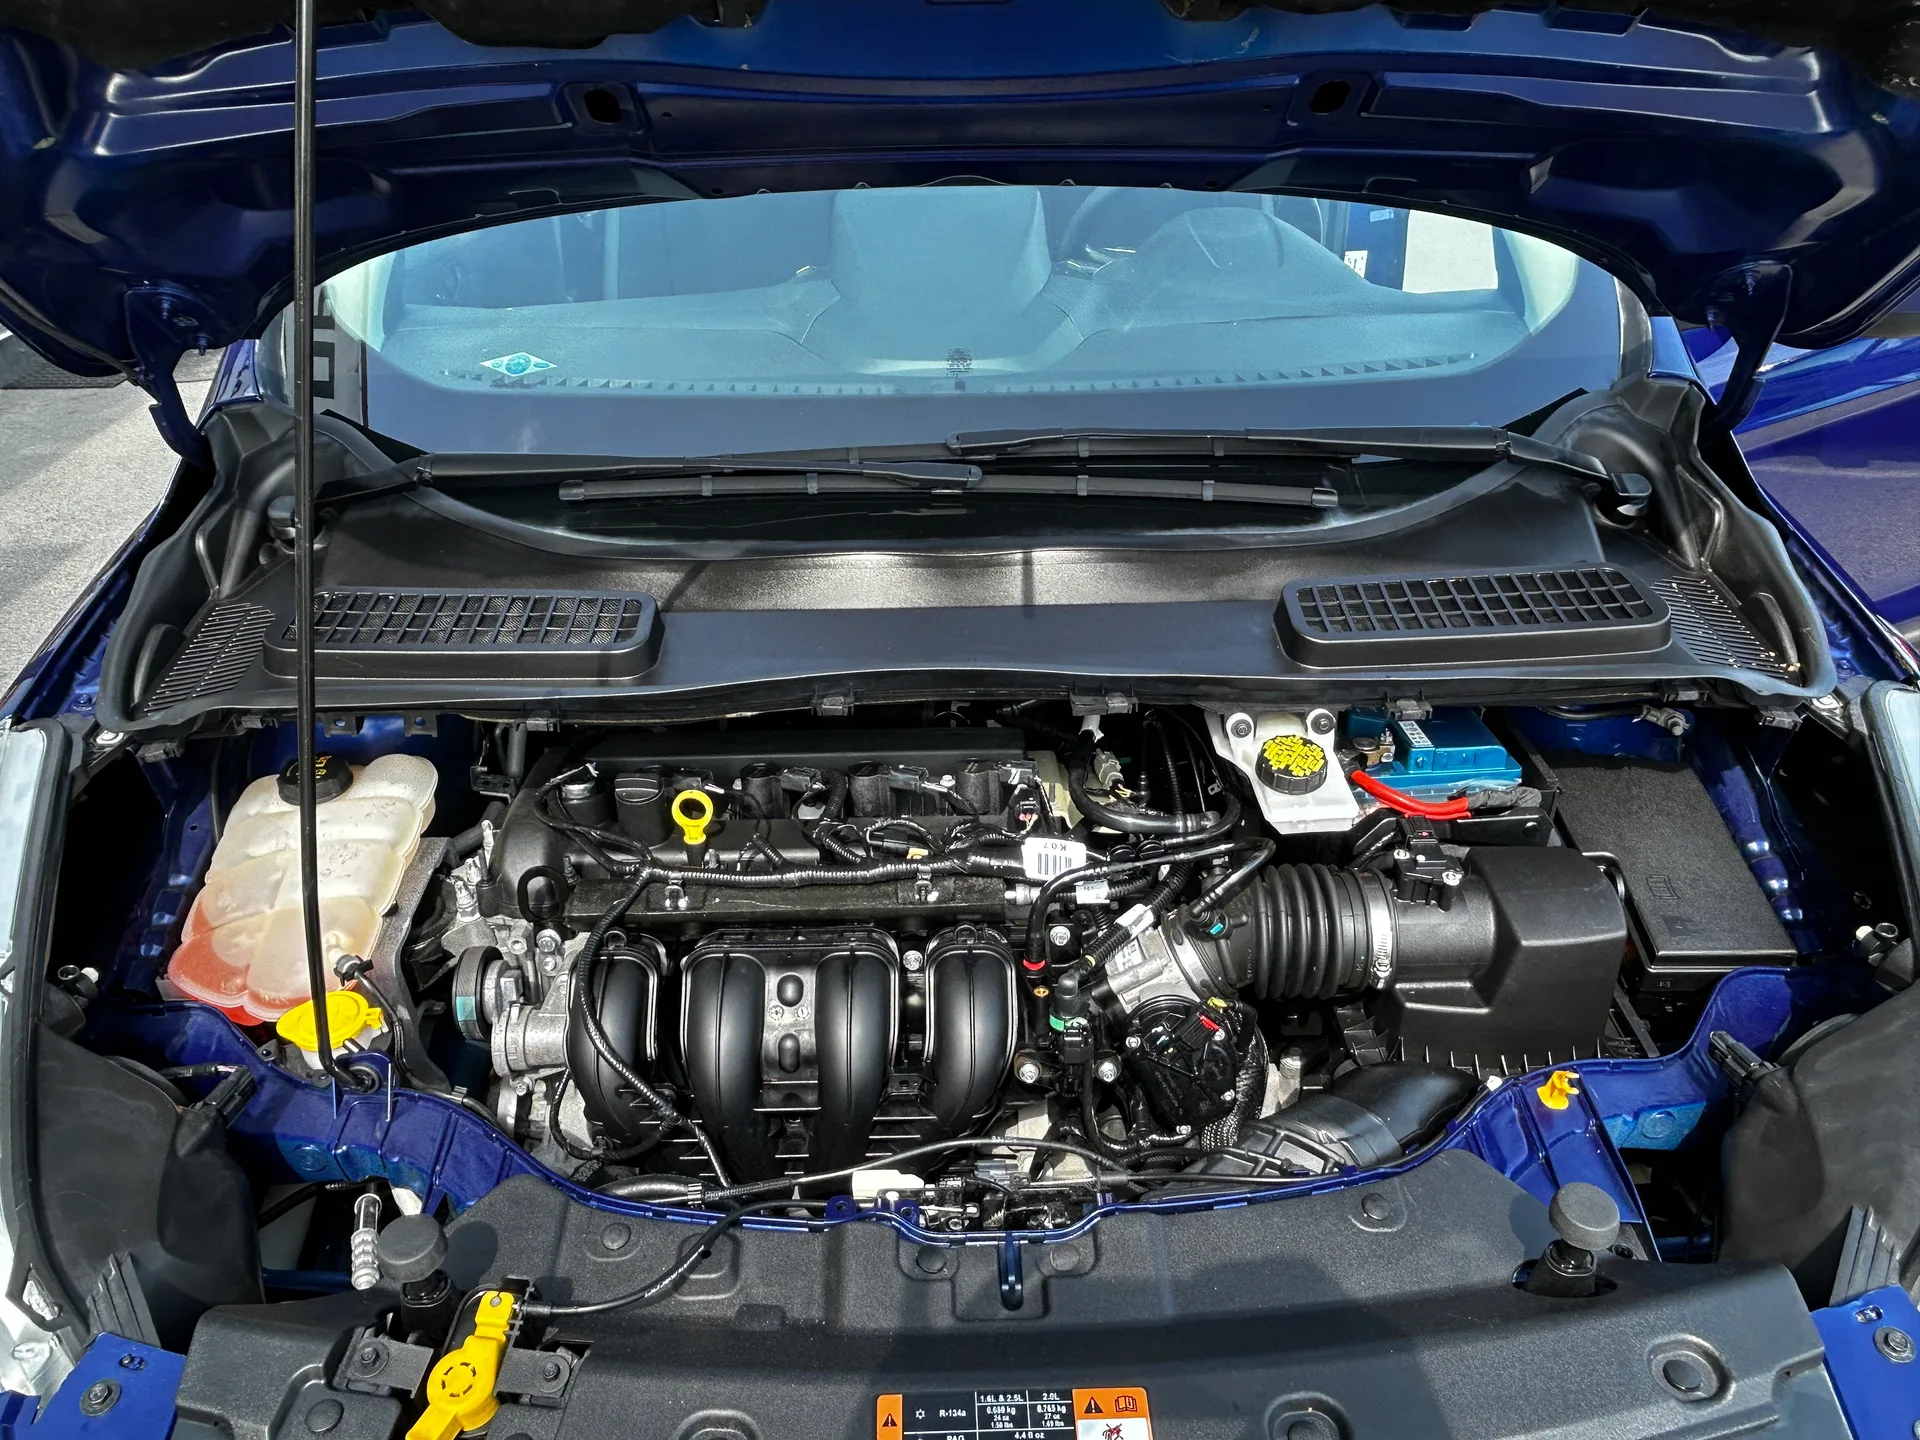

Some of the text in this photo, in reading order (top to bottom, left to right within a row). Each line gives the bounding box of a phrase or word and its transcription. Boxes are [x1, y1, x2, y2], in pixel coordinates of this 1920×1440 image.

[1043, 842, 1067, 851] K07
[980, 1394, 996, 1402] 1.6L
[1006, 1394, 1024, 1402] 2.5L
[1042, 1392, 1060, 1400] 2.0L
[939, 1409, 966, 1417] R-134a
[1006, 1405, 1016, 1415] kg
[1056, 1404, 1067, 1414] kg
